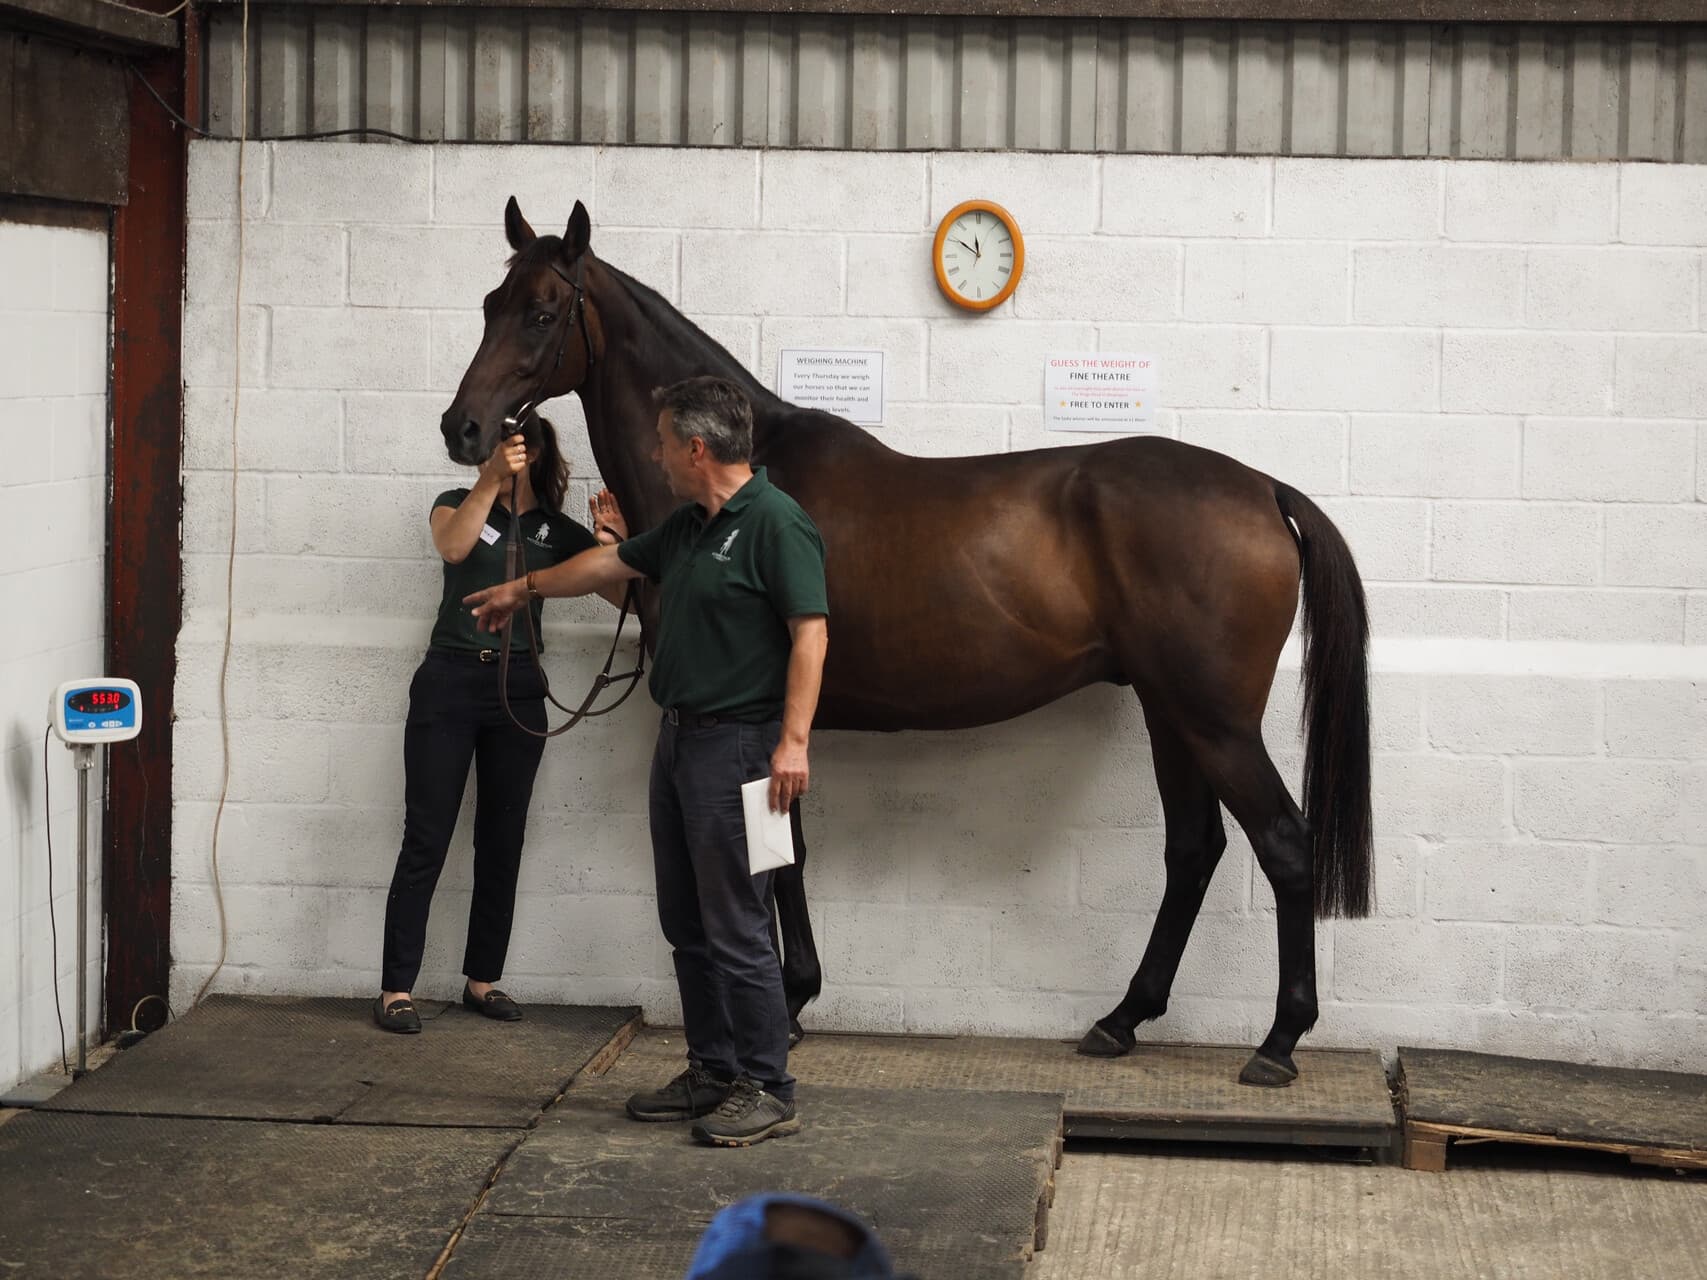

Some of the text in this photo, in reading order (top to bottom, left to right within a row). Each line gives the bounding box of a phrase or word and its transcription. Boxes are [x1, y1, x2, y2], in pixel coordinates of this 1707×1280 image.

[796, 357, 868, 366] WEIGHING MACHINE
[1050, 359, 1151, 369] GUESS THE WEIGHT OF
[793, 372, 811, 380] Every
[812, 373, 839, 381] Thursday
[1069, 372, 1131, 381] FINE THEATRE
[1070, 401, 1129, 409] FREE TO ENTER
[92, 692, 120, 705] 553.0
